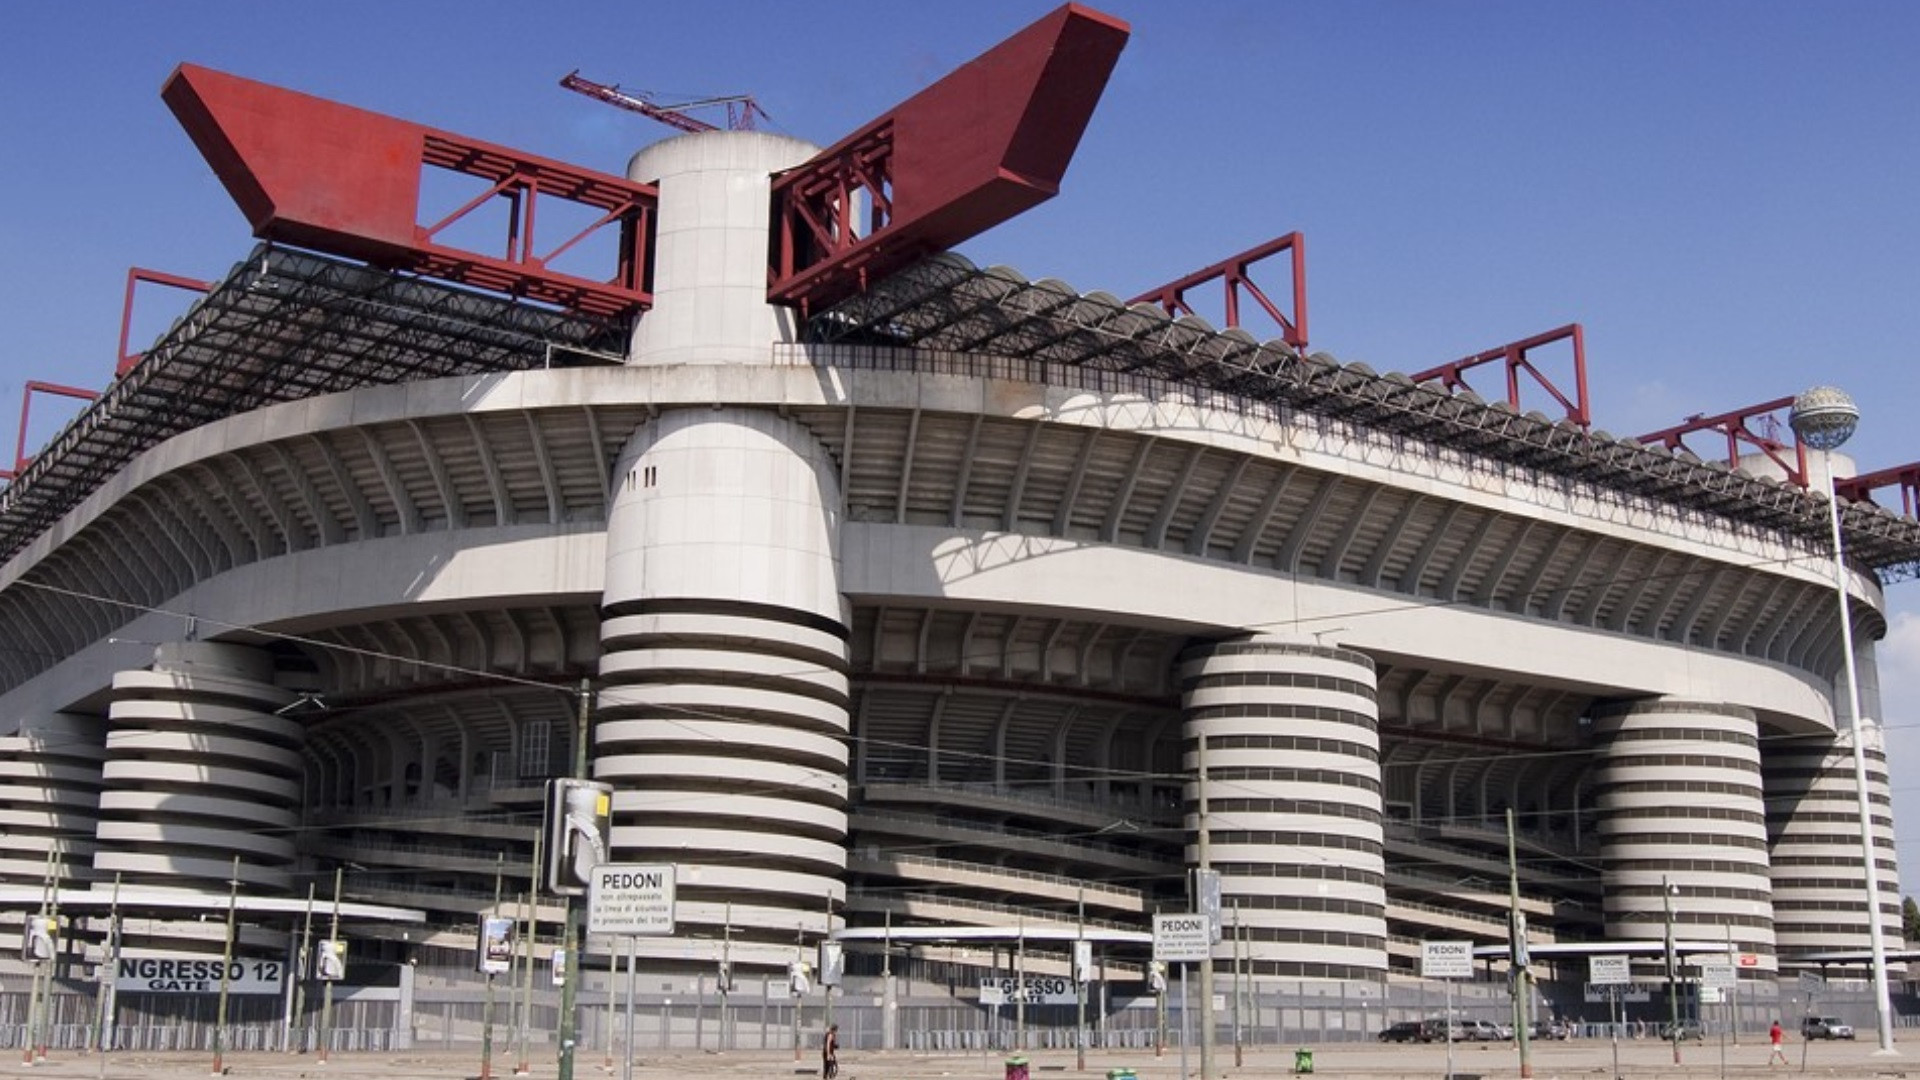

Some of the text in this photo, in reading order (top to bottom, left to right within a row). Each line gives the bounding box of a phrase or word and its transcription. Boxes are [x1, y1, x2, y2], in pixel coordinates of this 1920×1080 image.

[602, 873, 662, 889] PEDONI
[1161, 920, 1202, 931] PEDONI
[1428, 944, 1466, 954] PEDONI
[119, 958, 279, 982] NGRESSO 12
